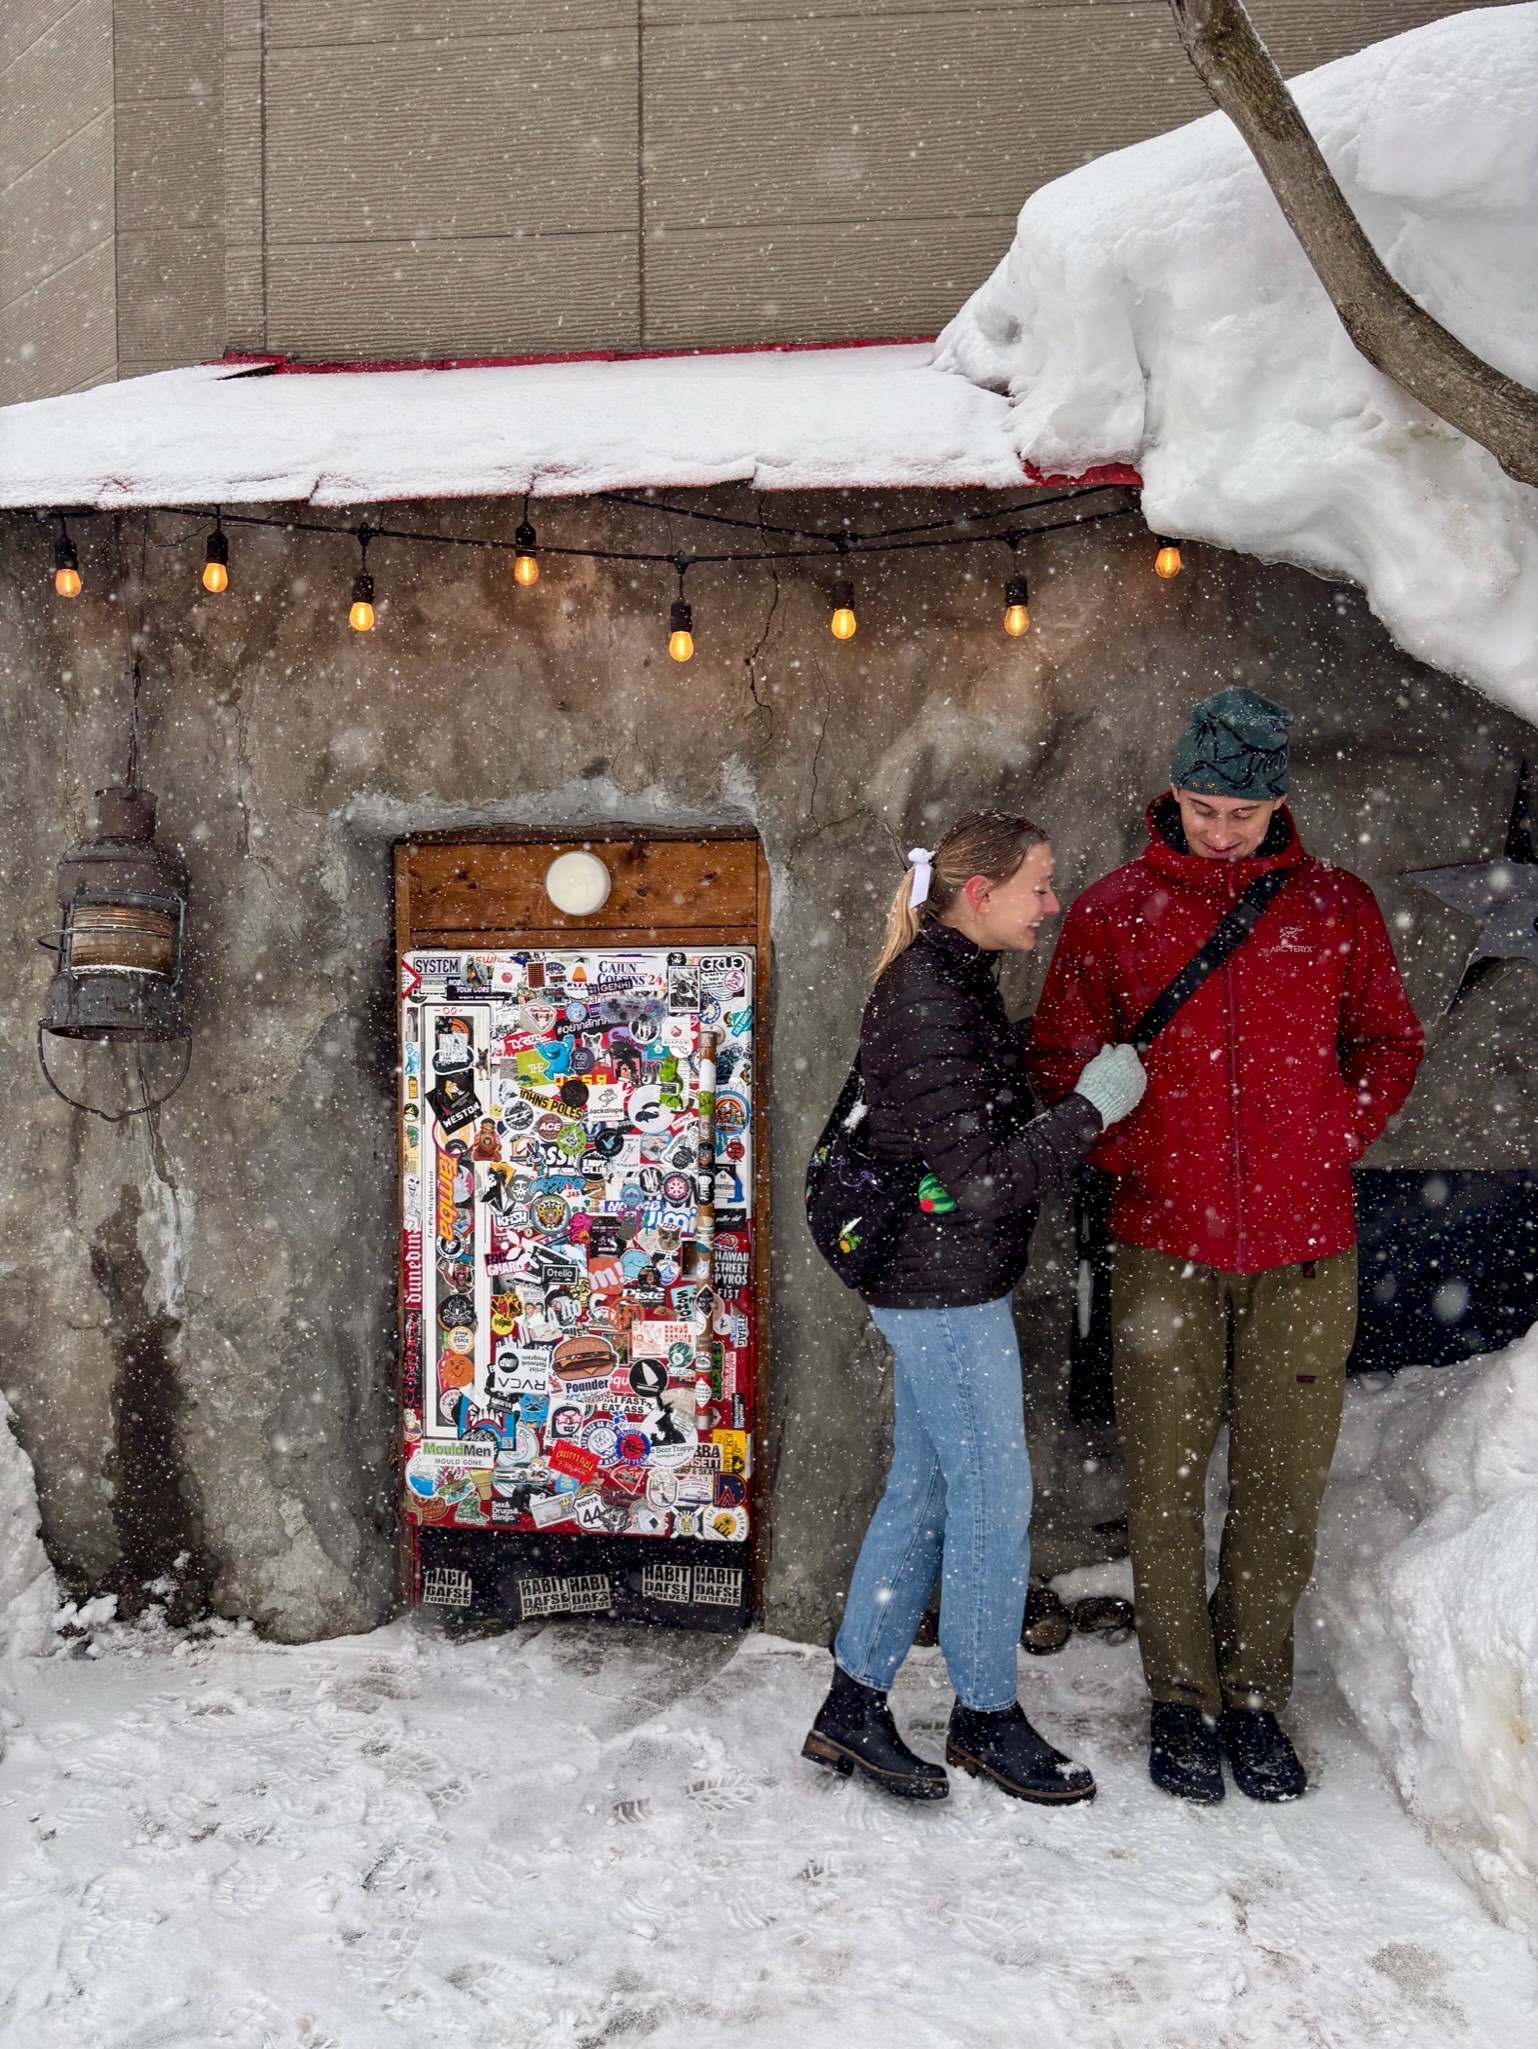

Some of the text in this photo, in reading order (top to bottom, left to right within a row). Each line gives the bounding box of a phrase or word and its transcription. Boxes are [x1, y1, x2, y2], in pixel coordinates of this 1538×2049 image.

[416, 960, 458, 973] SYSTEM
[599, 961, 637, 973] CAJUN
[443, 1102, 479, 1128] WESTON
[714, 1251, 749, 1262] HAWAII
[404, 1233, 422, 1303] dunedin
[714, 1262, 748, 1273] STREET
[714, 1273, 748, 1285] PYROS
[717, 1288, 740, 1299] FIST
[497, 1377, 546, 1390] RVCA
[565, 1380, 608, 1394] Pounder
[621, 1397, 646, 1405] FAST
[624, 1405, 644, 1413] ASS
[422, 1442, 492, 1456] MouldMen
[576, 1496, 598, 1507] ROUTE
[428, 1570, 469, 1587] HABIT
[645, 1565, 689, 1583] HABIT
[696, 1566, 741, 1586] HABIT
[426, 1585, 471, 1598] DAFSE
[521, 1577, 566, 1596] HABIT
[645, 1582, 689, 1595] DAFSE
[696, 1584, 740, 1598] DAFSE
[425, 1596, 470, 1605] FOREVER
[523, 1592, 570, 1608] DAFSE
[695, 1595, 740, 1605] FOREVER
[523, 1603, 570, 1615] FOREVER
